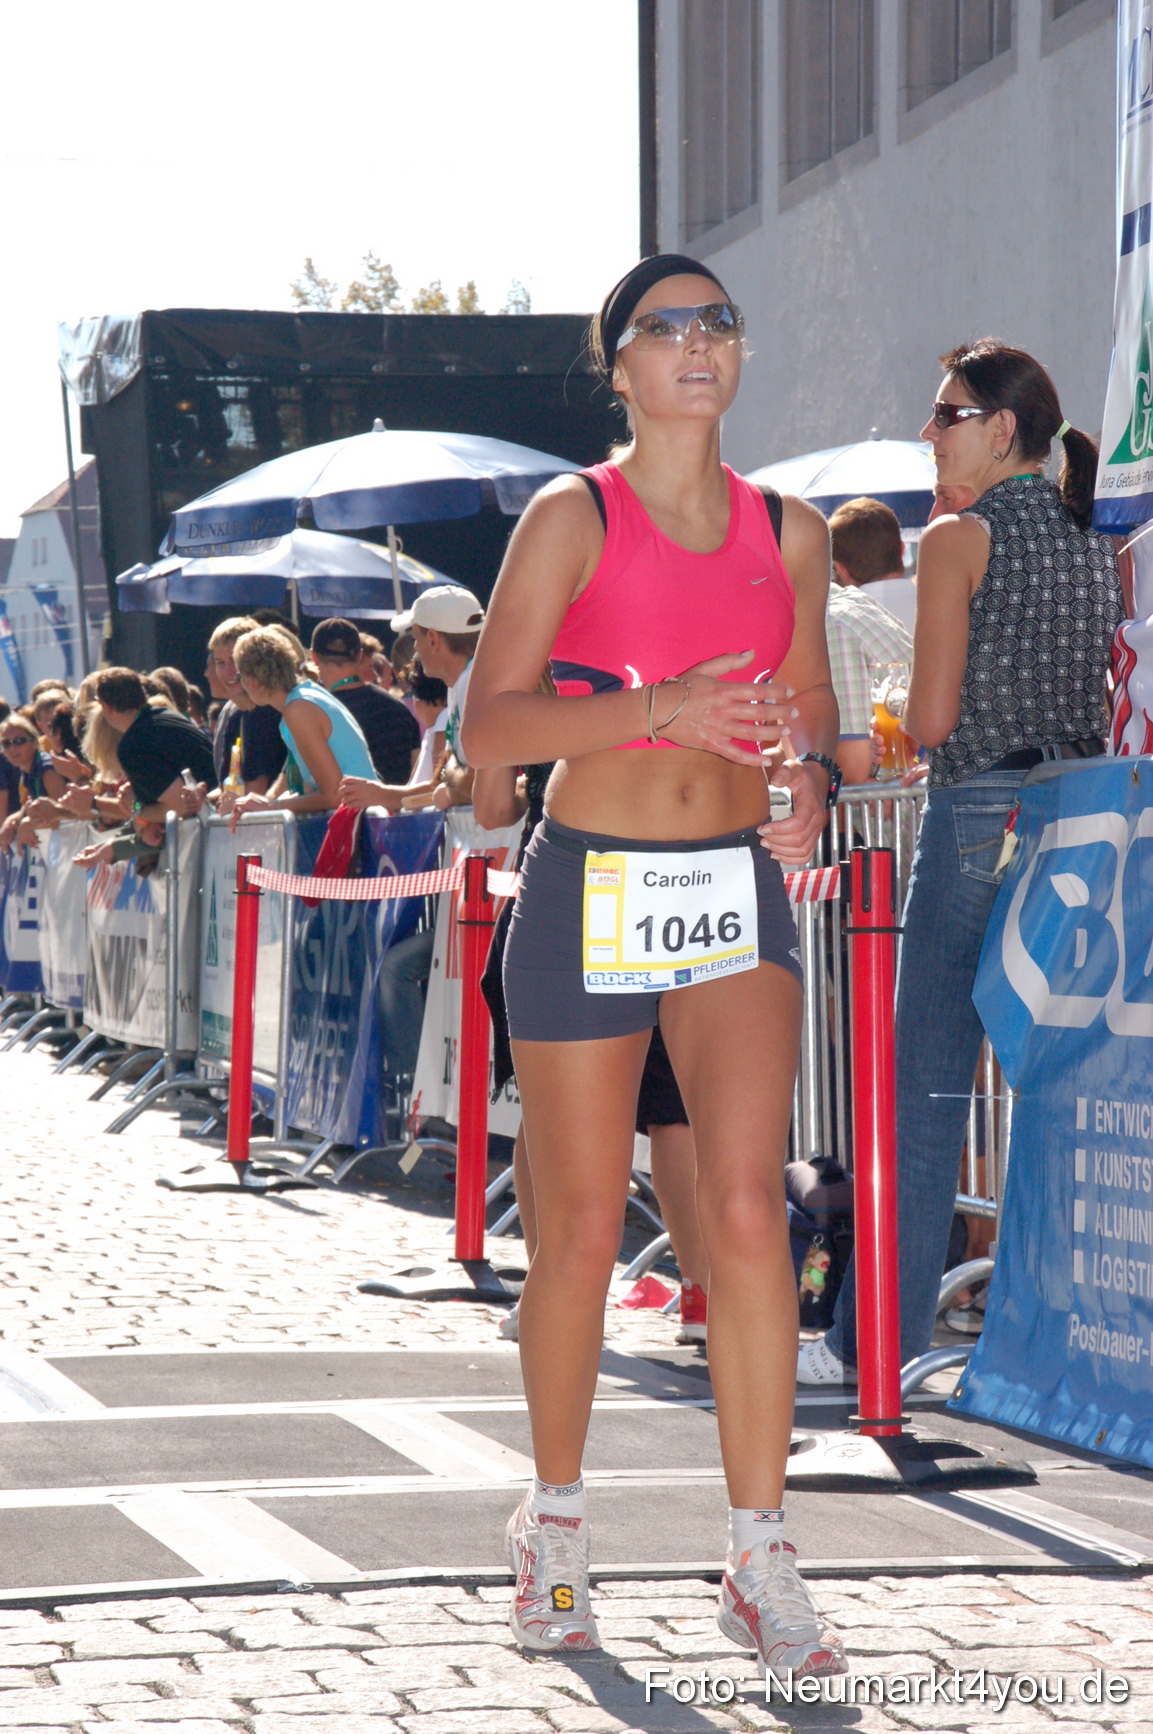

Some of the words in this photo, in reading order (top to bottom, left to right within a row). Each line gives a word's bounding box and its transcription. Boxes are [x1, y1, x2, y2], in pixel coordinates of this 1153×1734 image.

[643, 870, 712, 888] Carolin
[635, 911, 742, 953] 1046
[587, 972, 652, 985] BOCK
[693, 952, 756, 976] PFLEIDERER
[1095, 1099, 1153, 1140] ENTWIC
[1094, 1150, 1153, 1193] KUNSTS
[1094, 1202, 1153, 1246] ALUMINI
[1093, 1252, 1153, 1299] LOGISTI
[1069, 1313, 1153, 1367] Postbauer-
[555, 1587, 574, 1609] S
